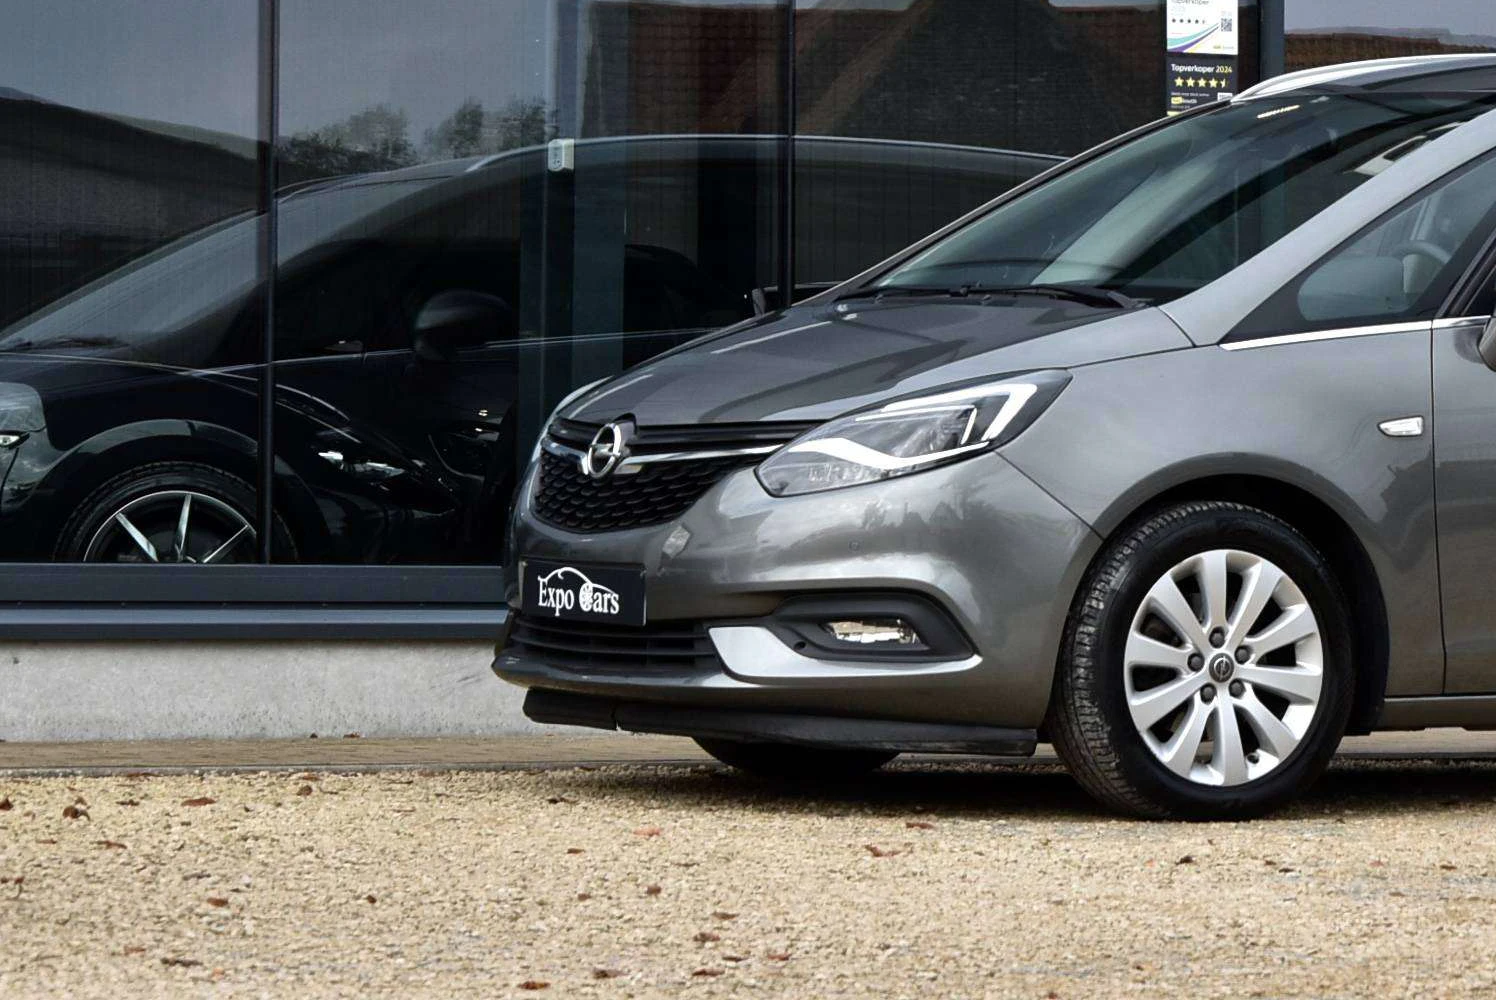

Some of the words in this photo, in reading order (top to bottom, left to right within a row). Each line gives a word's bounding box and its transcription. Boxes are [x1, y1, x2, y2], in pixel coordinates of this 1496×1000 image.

[1171, 63, 1215, 74] Topverkoper
[1215, 65, 1233, 74] 2024
[537, 577, 575, 617] Expo
[578, 581, 620, 615] Cars
